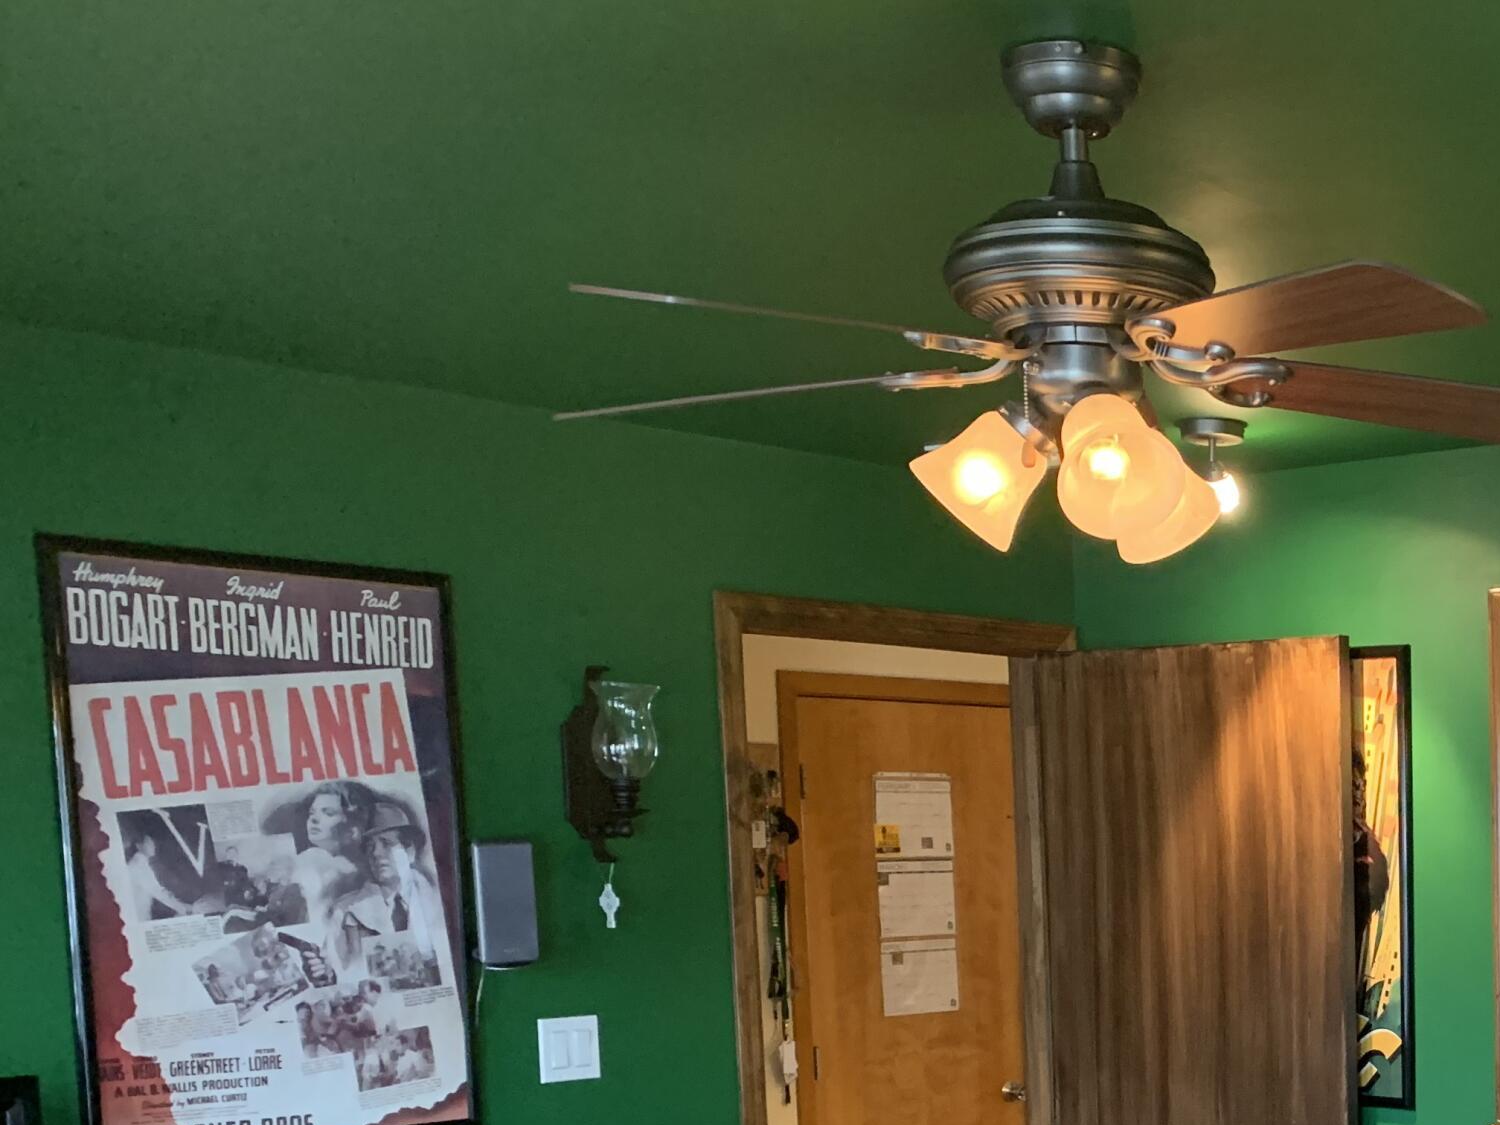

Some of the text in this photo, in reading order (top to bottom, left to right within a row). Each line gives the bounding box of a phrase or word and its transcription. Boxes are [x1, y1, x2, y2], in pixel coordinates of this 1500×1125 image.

[72, 561, 165, 592] Humphrey
[226, 575, 284, 601] Ingrid
[360, 589, 402, 611] Paul
[66, 586, 434, 670] BOGART BERGMAN HENREID
[87, 681, 417, 799] CASABLANCA
[169, 1056, 241, 1078] GREENSTREET
[202, 1076, 269, 1091] PRODUCTION
[186, 1095, 220, 1106] MICHAEL
